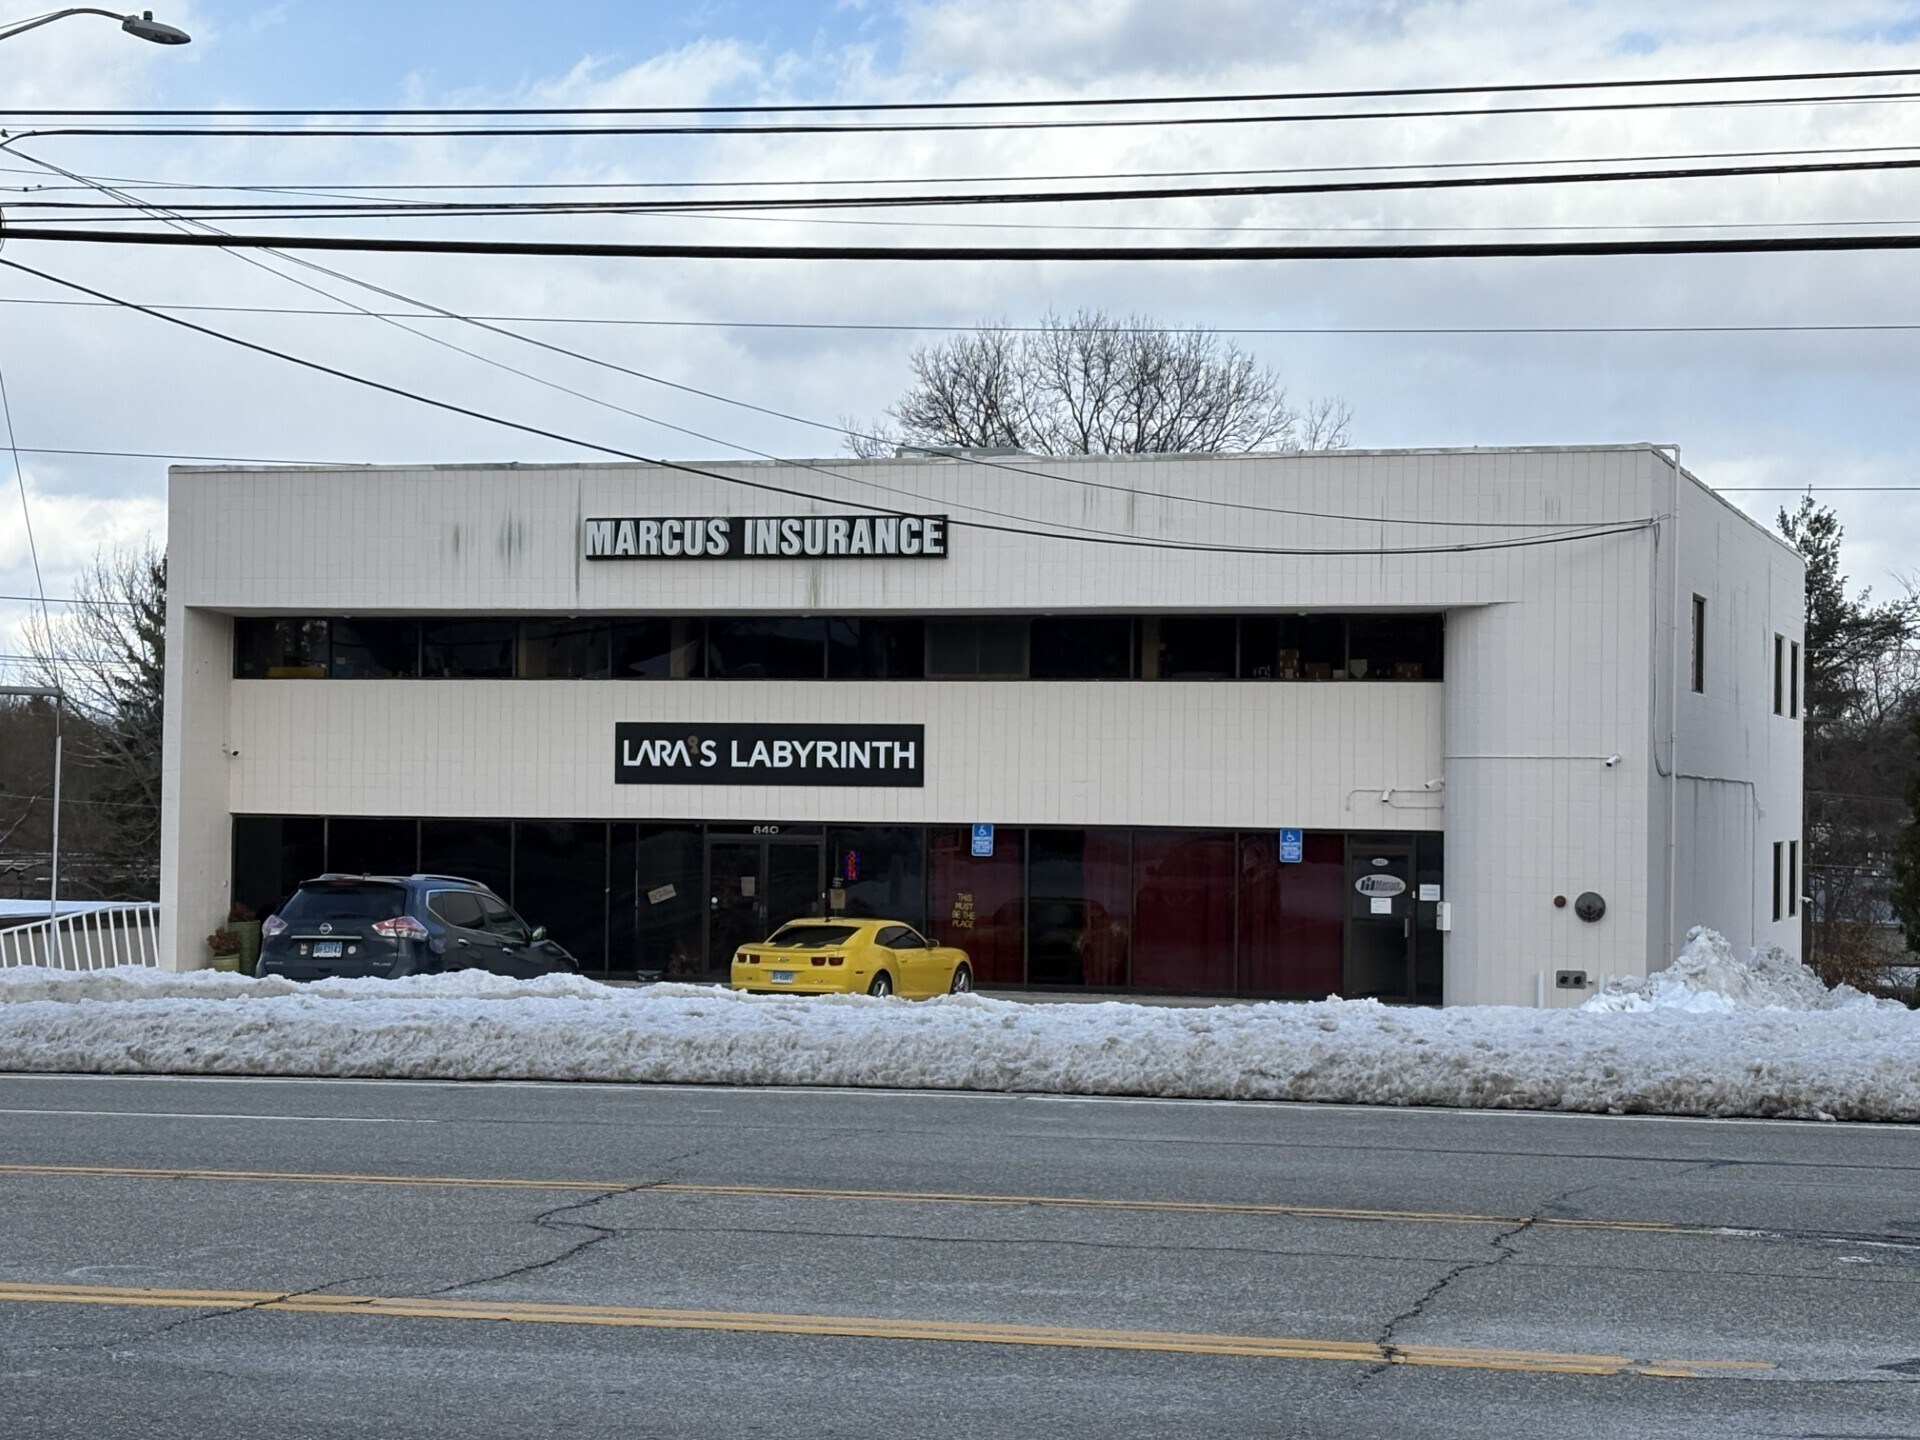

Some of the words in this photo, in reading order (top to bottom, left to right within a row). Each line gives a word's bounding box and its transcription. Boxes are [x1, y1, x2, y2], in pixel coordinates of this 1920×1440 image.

[586, 519, 730, 556] MARCUS
[744, 517, 945, 555] INSURANCE
[730, 740, 915, 769] LABYRINTH
[752, 825, 779, 835] 840
[954, 902, 974, 911] MUST
[951, 920, 976, 929] PLACE
